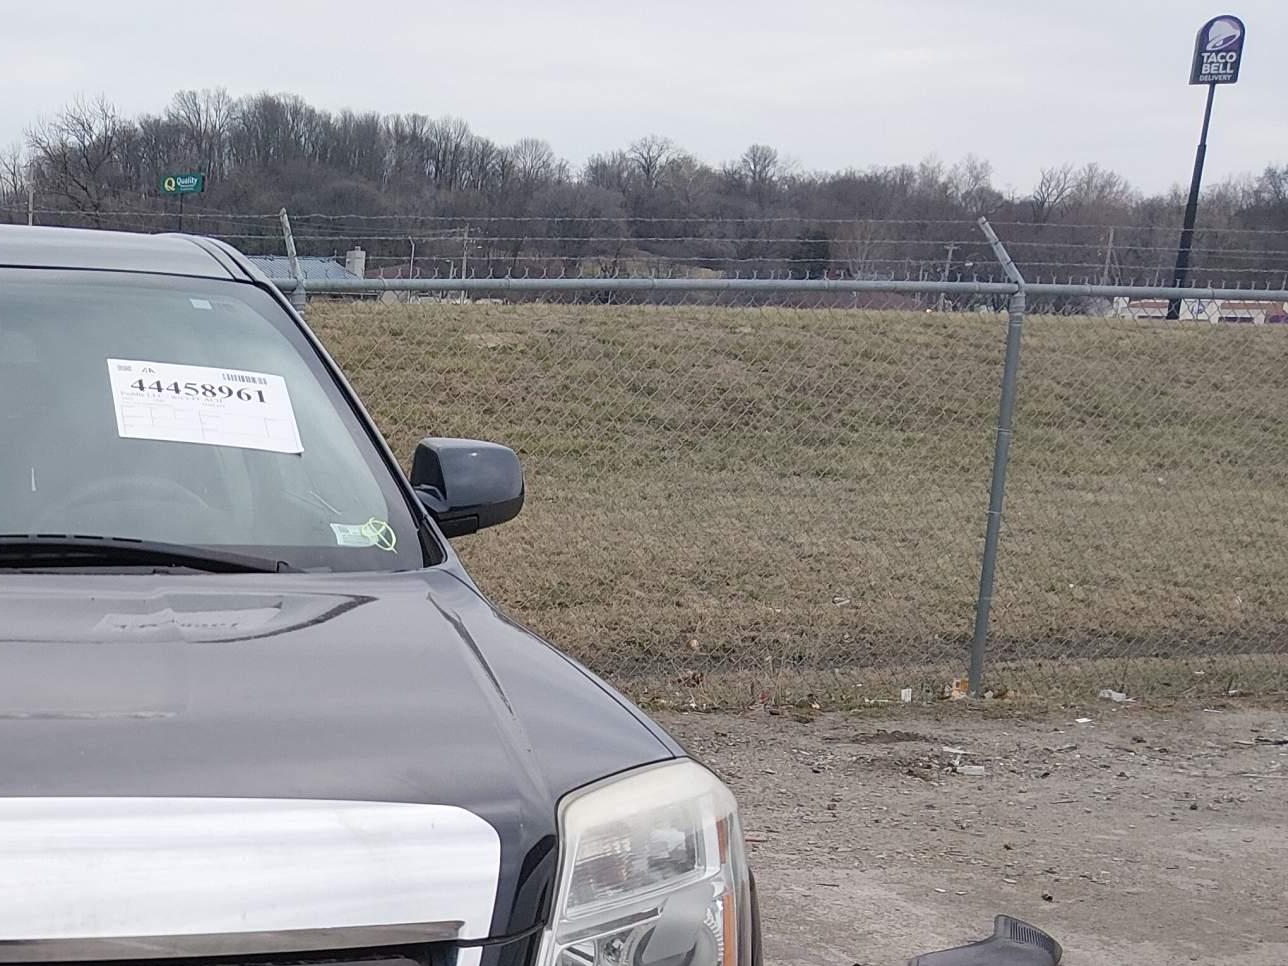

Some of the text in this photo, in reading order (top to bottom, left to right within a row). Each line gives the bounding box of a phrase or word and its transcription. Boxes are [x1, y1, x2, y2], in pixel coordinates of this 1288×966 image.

[1201, 52, 1237, 63] TACO
[1201, 63, 1234, 74] BELL
[176, 176, 198, 187] Quality
[130, 379, 267, 404] 44458961
